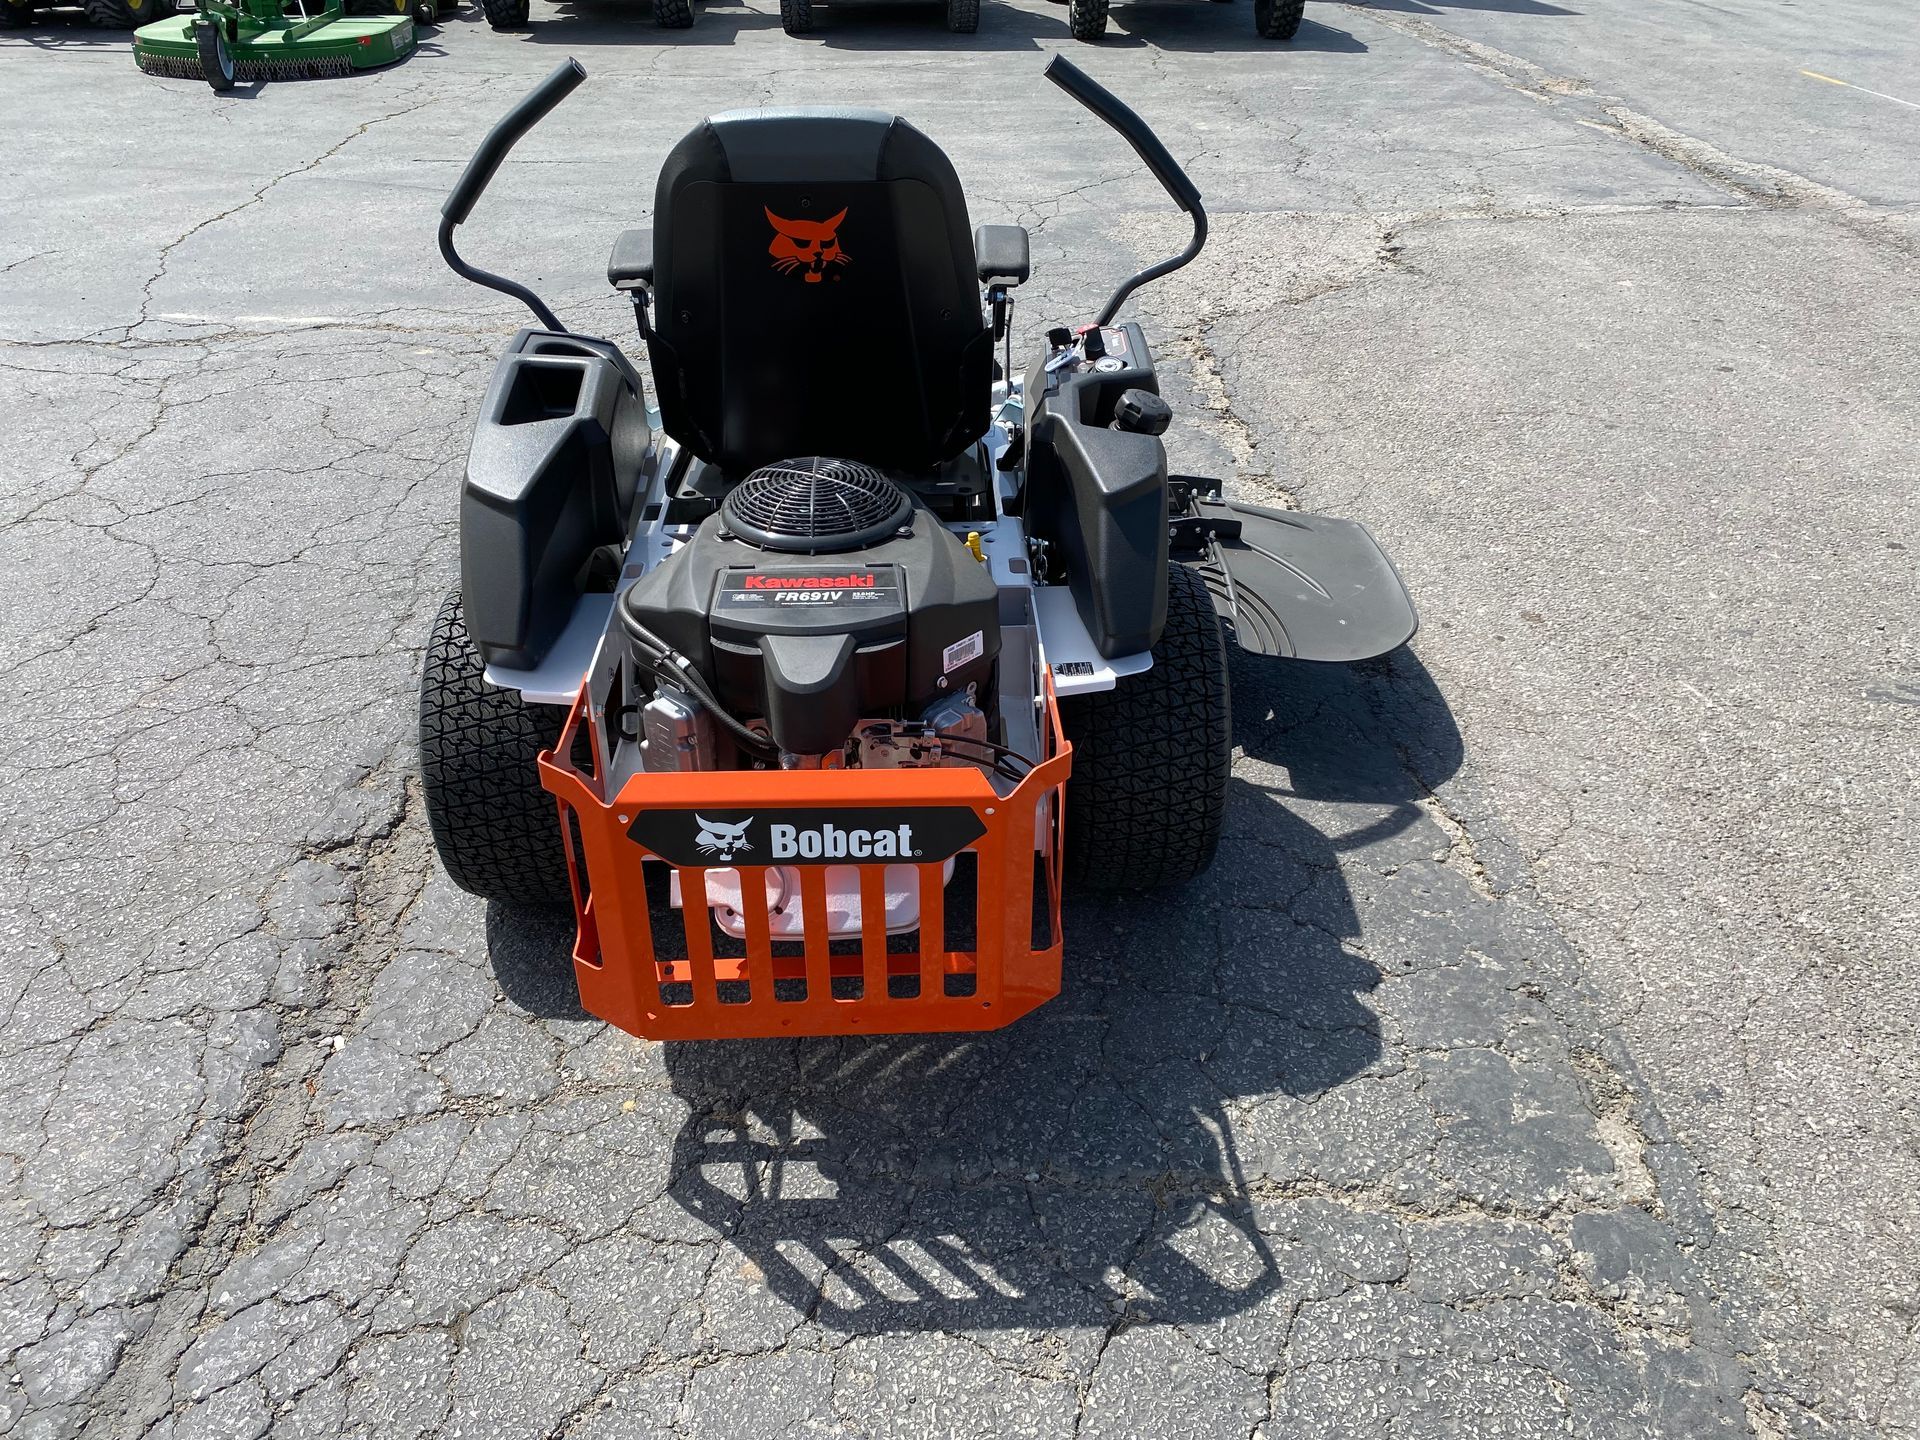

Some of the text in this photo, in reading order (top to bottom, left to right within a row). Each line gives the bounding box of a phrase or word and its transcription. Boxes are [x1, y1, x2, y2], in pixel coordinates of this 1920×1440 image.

[745, 574, 874, 589] Kawasaki
[775, 591, 843, 601] FR691V
[770, 824, 913, 859] Bobcat
